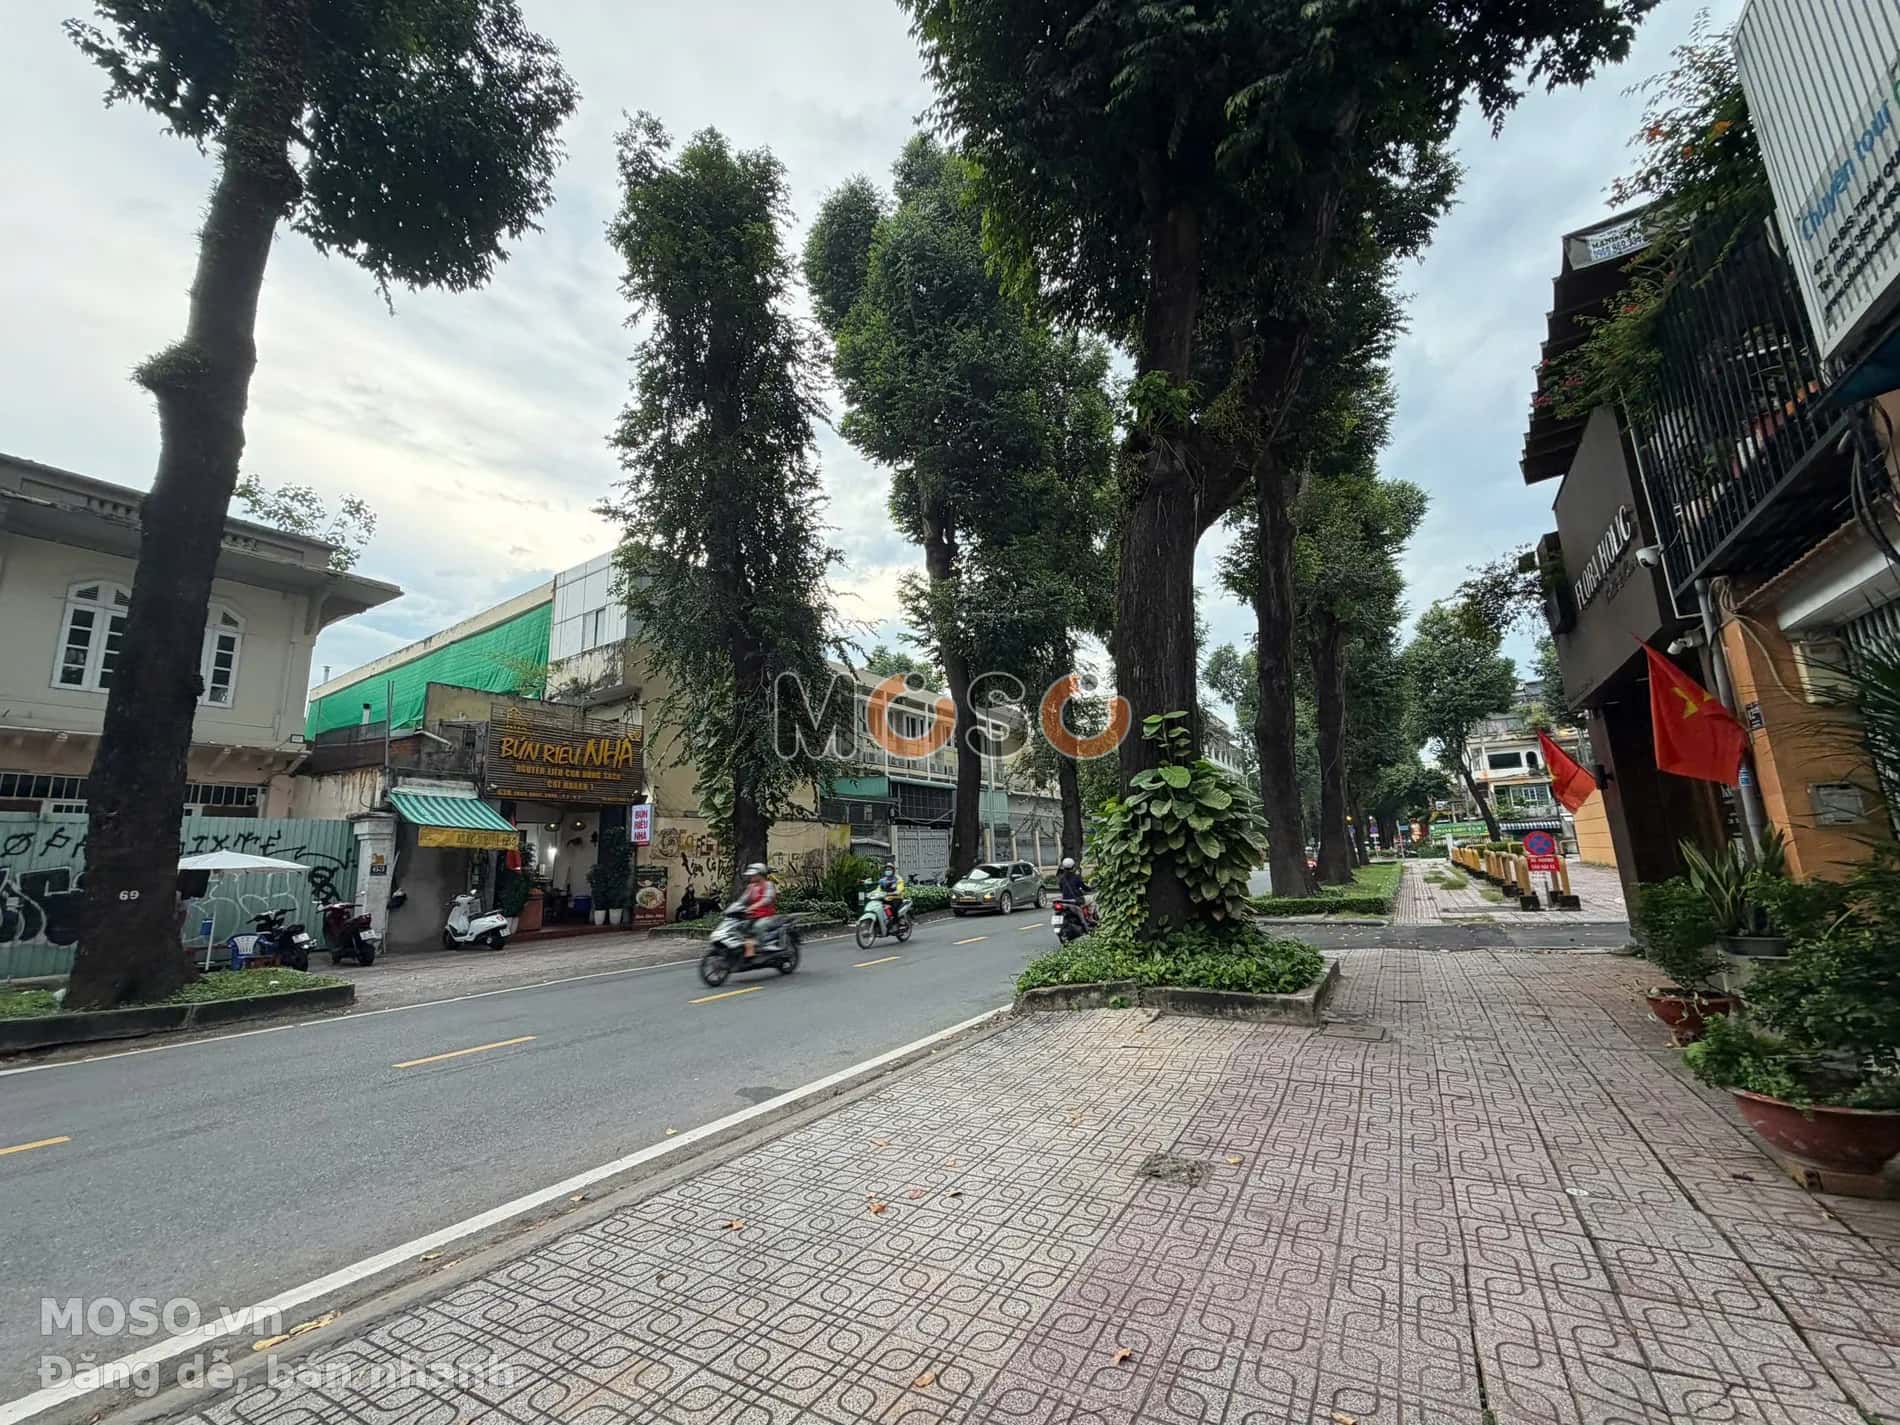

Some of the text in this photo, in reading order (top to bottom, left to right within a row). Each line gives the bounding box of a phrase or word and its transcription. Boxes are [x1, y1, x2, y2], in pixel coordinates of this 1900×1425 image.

[1856, 100, 1891, 162] tour
[1574, 555, 1602, 611] FLORA
[1597, 504, 1631, 575] HOLIC
[500, 735, 540, 760] BÚN
[543, 741, 581, 765] RIÊU
[119, 890, 140, 901] 69
